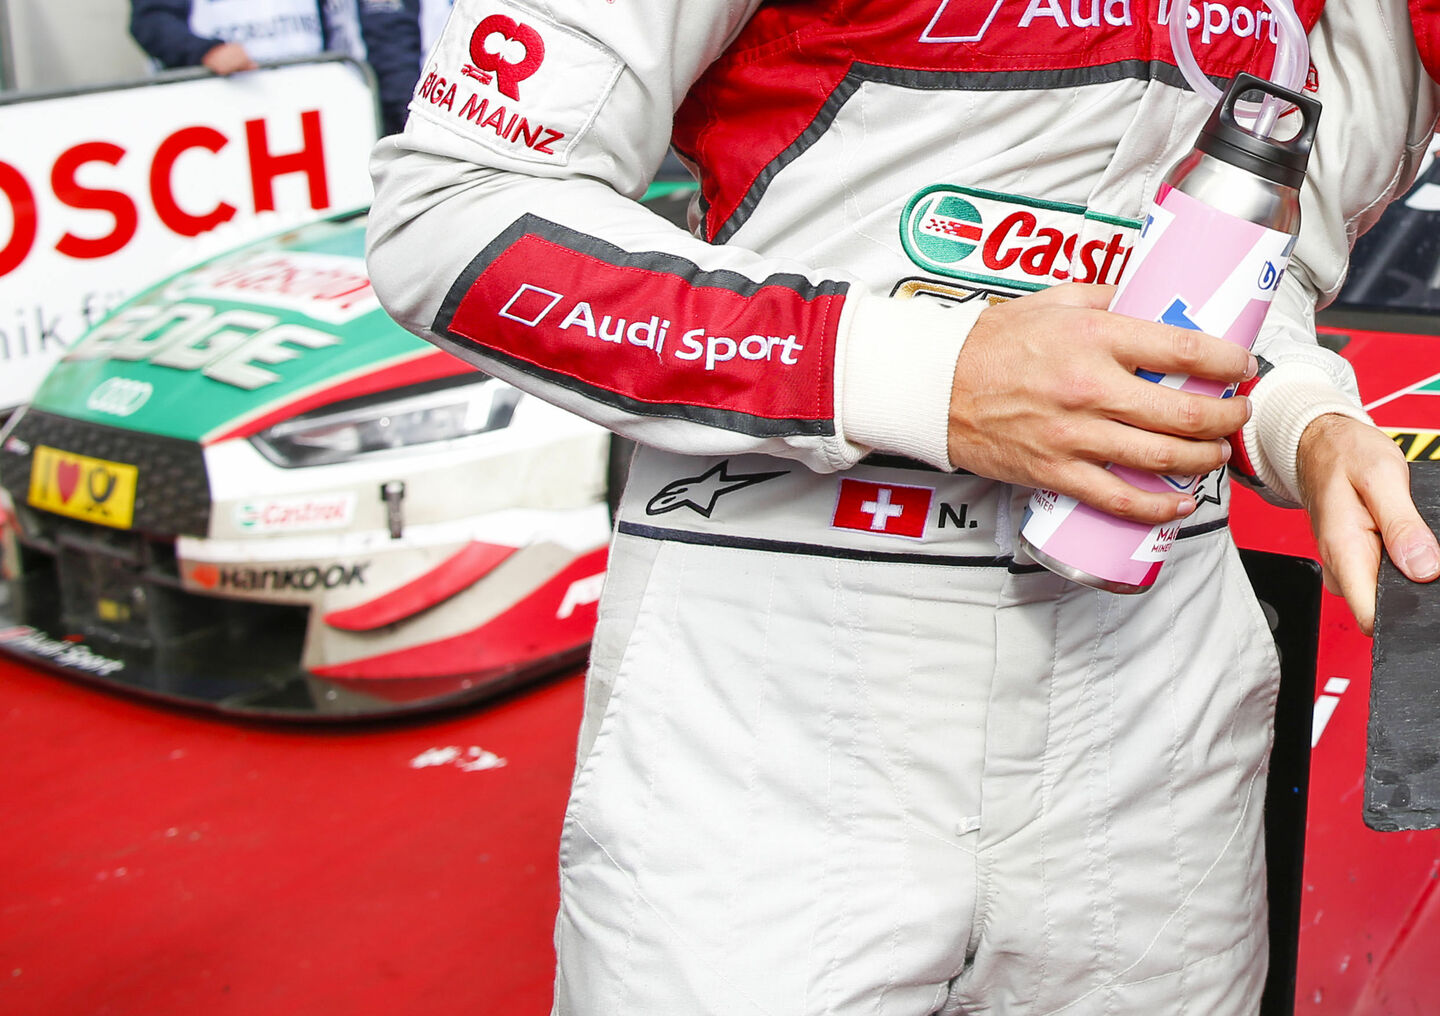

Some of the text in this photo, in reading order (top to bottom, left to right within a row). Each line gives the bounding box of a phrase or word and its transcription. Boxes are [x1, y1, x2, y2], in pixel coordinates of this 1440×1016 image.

[458, 93, 566, 156] MAINZ
[558, 302, 804, 371] Audi Sport
[261, 499, 347, 526] Castrol
[938, 502, 978, 528] N.
